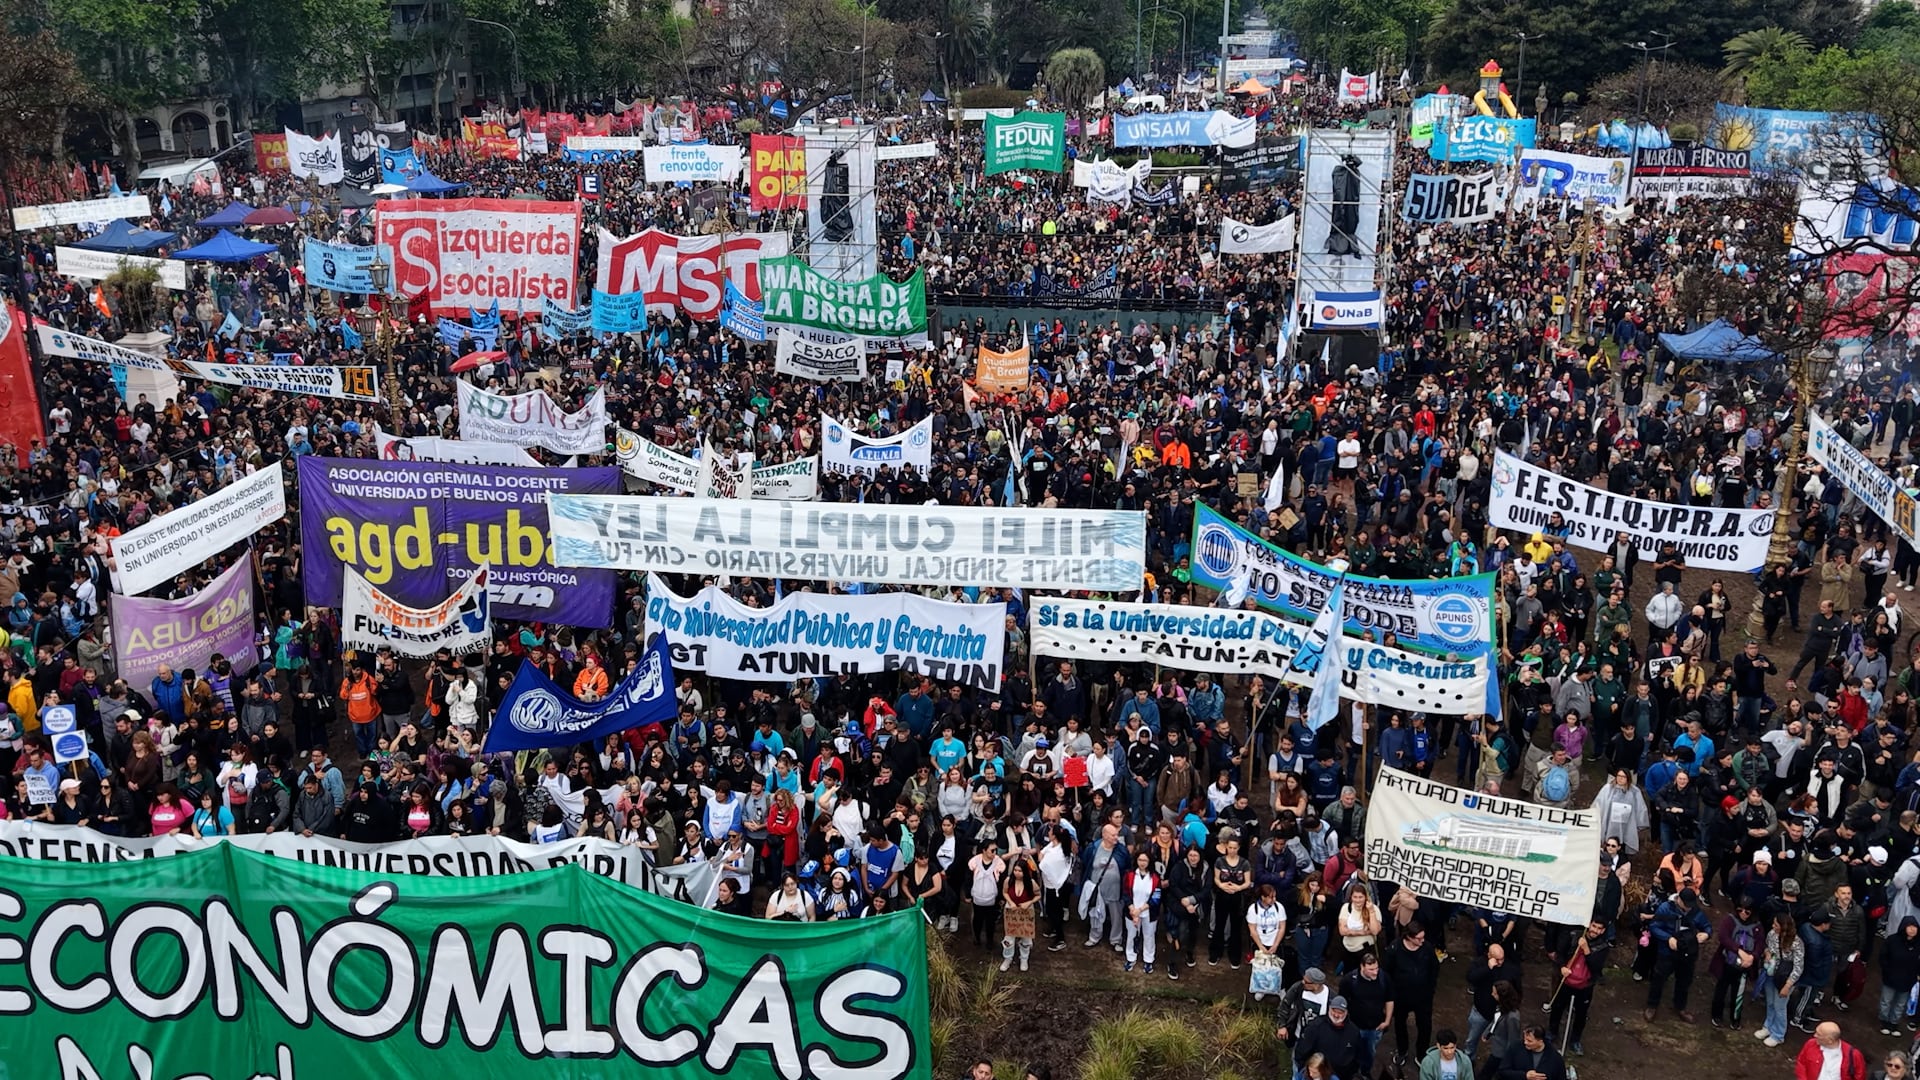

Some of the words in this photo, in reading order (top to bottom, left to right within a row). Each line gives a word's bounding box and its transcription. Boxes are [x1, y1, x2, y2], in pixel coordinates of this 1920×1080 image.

[996, 122, 1055, 148] FEDUN
[1128, 120, 1191, 140] UNSAM
[660, 158, 724, 173] renovador
[671, 147, 706, 160] frente
[1691, 150, 1747, 168] FIERRO
[584, 177, 598, 192] E
[1408, 177, 1494, 220] SURGE
[441, 221, 571, 260] izquierda
[442, 265, 568, 300] socialista
[613, 238, 763, 318] MST
[764, 264, 875, 307] MARCHA
[879, 283, 911, 308] DE
[764, 291, 794, 318] LA
[802, 294, 914, 331] BRONCA
[1337, 308, 1373, 318] UNaB
[792, 339, 857, 361] CESACO
[234, 371, 252, 380] NO
[256, 373, 279, 383] HAY
[285, 373, 333, 387] FUTURO
[997, 366, 1029, 377] Brown
[241, 379, 273, 389] MARTIN
[277, 382, 331, 395] ZELARRAYAN
[469, 430, 480, 440] de
[481, 431, 489, 442] la
[328, 467, 420, 485] ASOCIACIÓN
[426, 471, 491, 487] GREMIAL
[496, 475, 569, 489] DOCENTE
[826, 460, 852, 475] SEDE
[1826, 442, 1838, 462] NO
[1840, 454, 1856, 478] HAY
[1857, 469, 1889, 507] FUTURO
[332, 482, 428, 500] UNIVERSIDAD
[431, 487, 451, 499] DE
[454, 488, 519, 503] BUENOS
[522, 491, 548, 505] AIR
[121, 543, 136, 557] NO
[136, 528, 167, 550] EXISTE
[166, 508, 210, 536] MOVILIDAD
[209, 496, 236, 516] SOCIAL
[235, 474, 276, 502] ASCENDENTE
[125, 557, 142, 573] SIN
[143, 531, 198, 566] UNIVERSIDAD
[199, 529, 205, 538] Y
[204, 522, 218, 535] SIN
[218, 507, 245, 527] ESTADO
[244, 490, 275, 514] PRESENTE
[1591, 526, 1600, 543] Y
[1203, 533, 1234, 571] FATUN
[446, 567, 508, 583] CONDU
[509, 568, 578, 586] HISTÓRICA
[1435, 612, 1474, 624] APUNGS
[391, 619, 463, 643] SIEMPRE
[683, 602, 791, 648] Universidad
[793, 610, 872, 649] Pública
[874, 618, 892, 655] y
[893, 614, 987, 661] Gratuita
[1063, 613, 1079, 628] a
[1083, 608, 1105, 631] la
[1109, 609, 1256, 640] Universidad
[1347, 648, 1365, 671] y
[1368, 647, 1477, 680] Gratuita
[1378, 768, 1458, 804] ARTURO
[1386, 842, 1499, 877] UNIVERSIDAD
[1500, 866, 1532, 888] DEL
[1367, 864, 1491, 906] ROTAGONISTAS
[1492, 898, 1516, 914] DE
[1519, 901, 1544, 917] LA
[1450, 874, 1506, 897] FORMA
[1508, 885, 1521, 899] A
[1523, 887, 1560, 906] LOS
